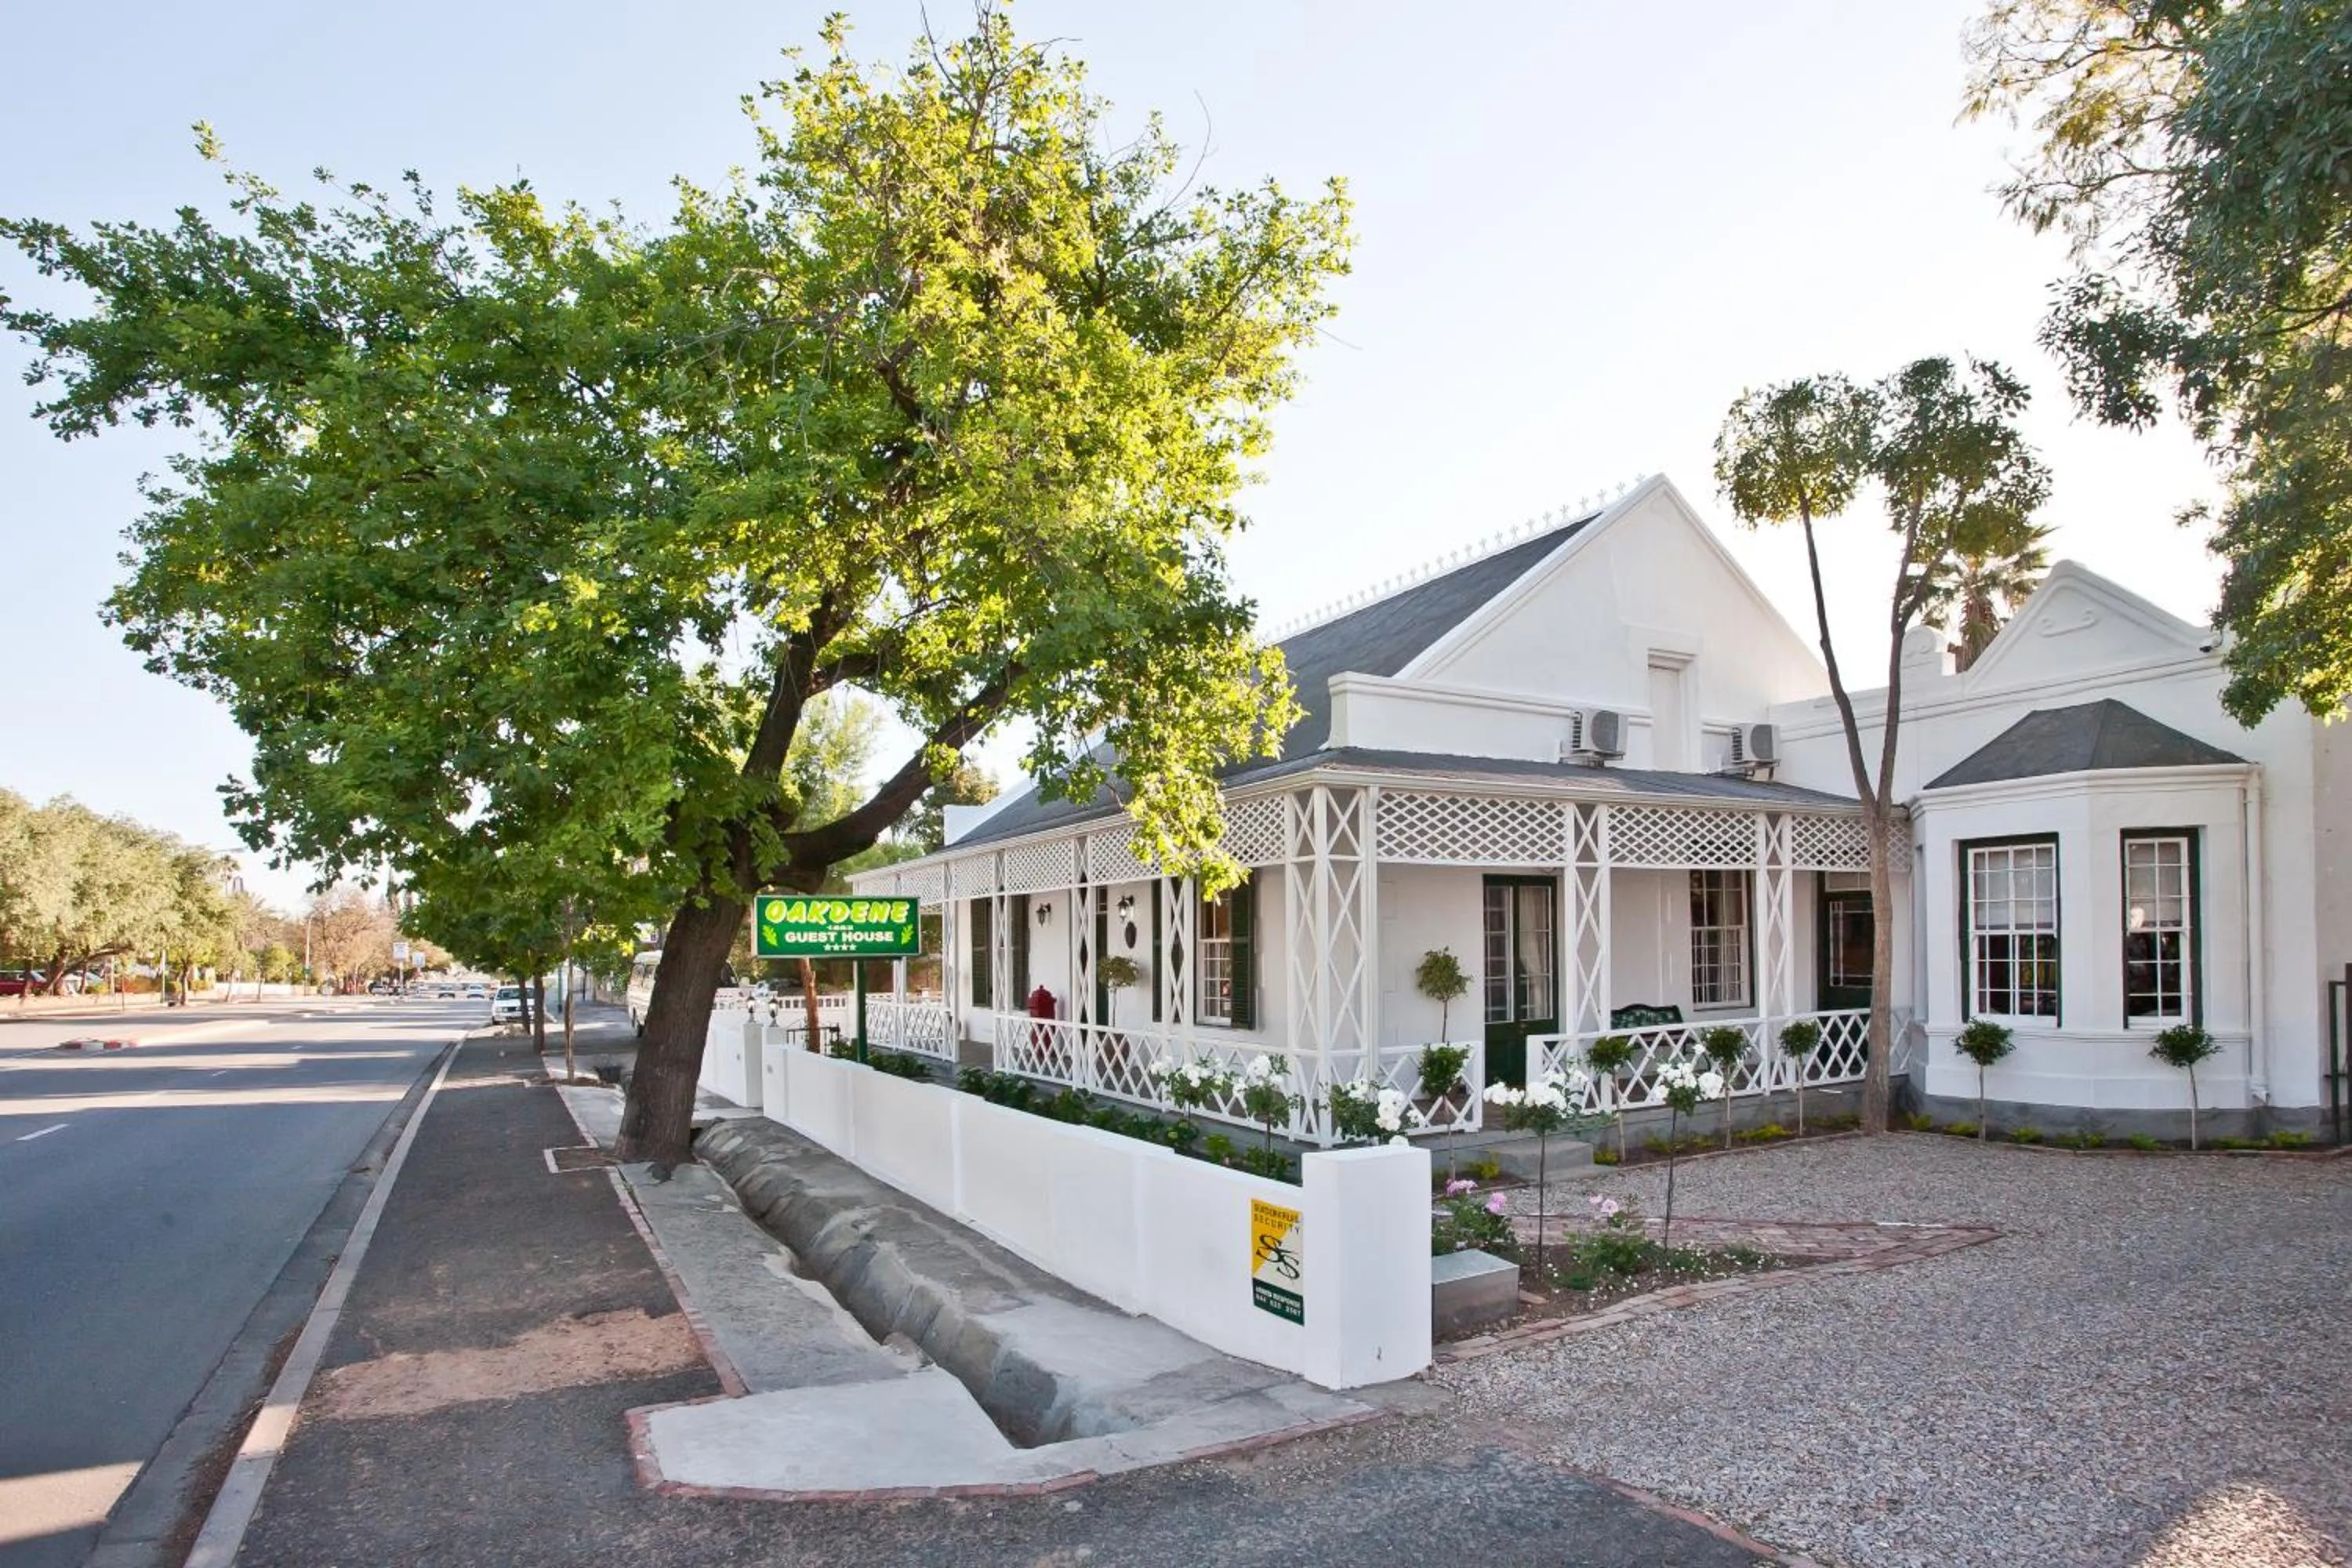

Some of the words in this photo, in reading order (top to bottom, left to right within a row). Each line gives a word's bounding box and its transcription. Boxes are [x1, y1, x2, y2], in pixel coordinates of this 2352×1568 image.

[764, 899, 910, 924] OAKDENE
[785, 931, 837, 943] GUEST
[842, 931, 895, 942] HOUSE
[1254, 1214, 1301, 1235] SECURITY
